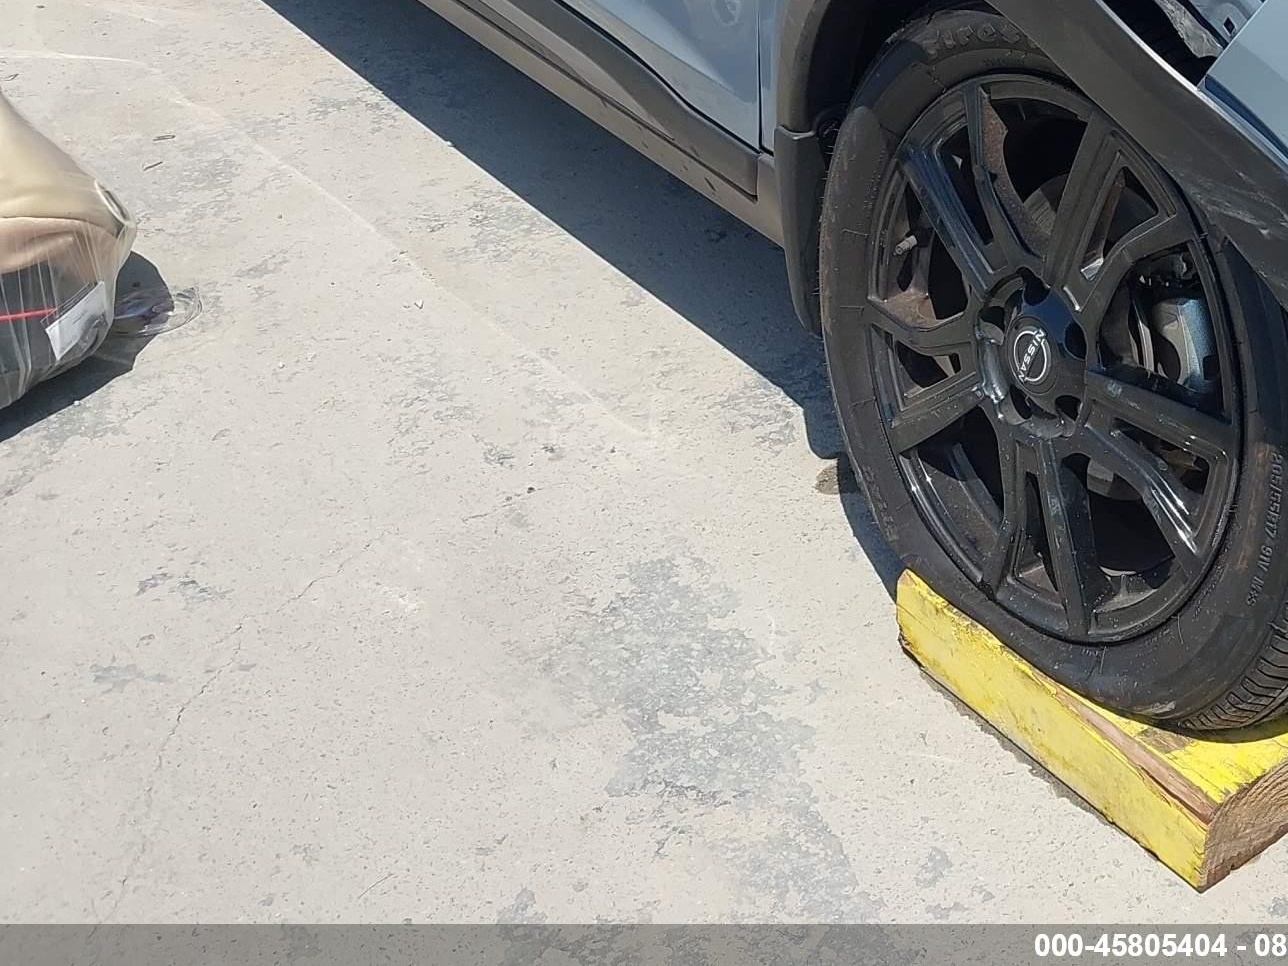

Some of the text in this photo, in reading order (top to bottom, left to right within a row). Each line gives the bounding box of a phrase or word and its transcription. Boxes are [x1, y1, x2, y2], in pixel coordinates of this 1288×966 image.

[1018, 328, 1047, 384] NISSAN
[1265, 452, 1284, 540] 205/55R17
[1257, 545, 1273, 572] 91V
